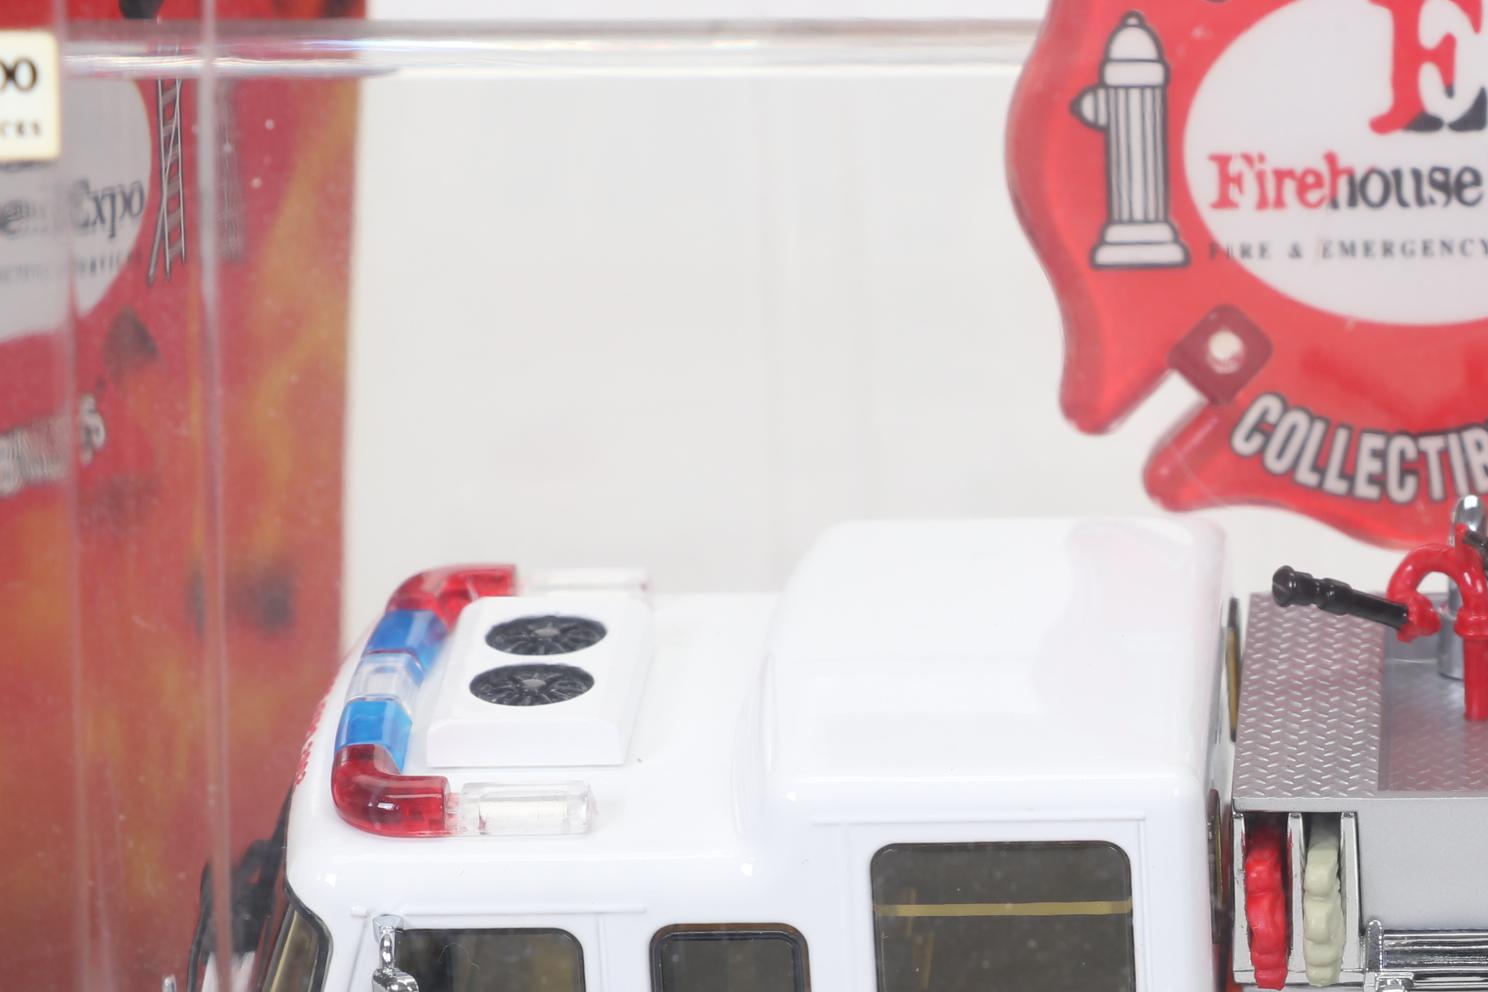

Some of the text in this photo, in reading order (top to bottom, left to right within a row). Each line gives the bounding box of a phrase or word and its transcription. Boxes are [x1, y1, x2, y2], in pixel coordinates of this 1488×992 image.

[1368, 0, 1488, 135] E
[1208, 150, 1483, 211] Firehouse
[1208, 239, 1272, 261] FIRE
[1288, 241, 1303, 259] &
